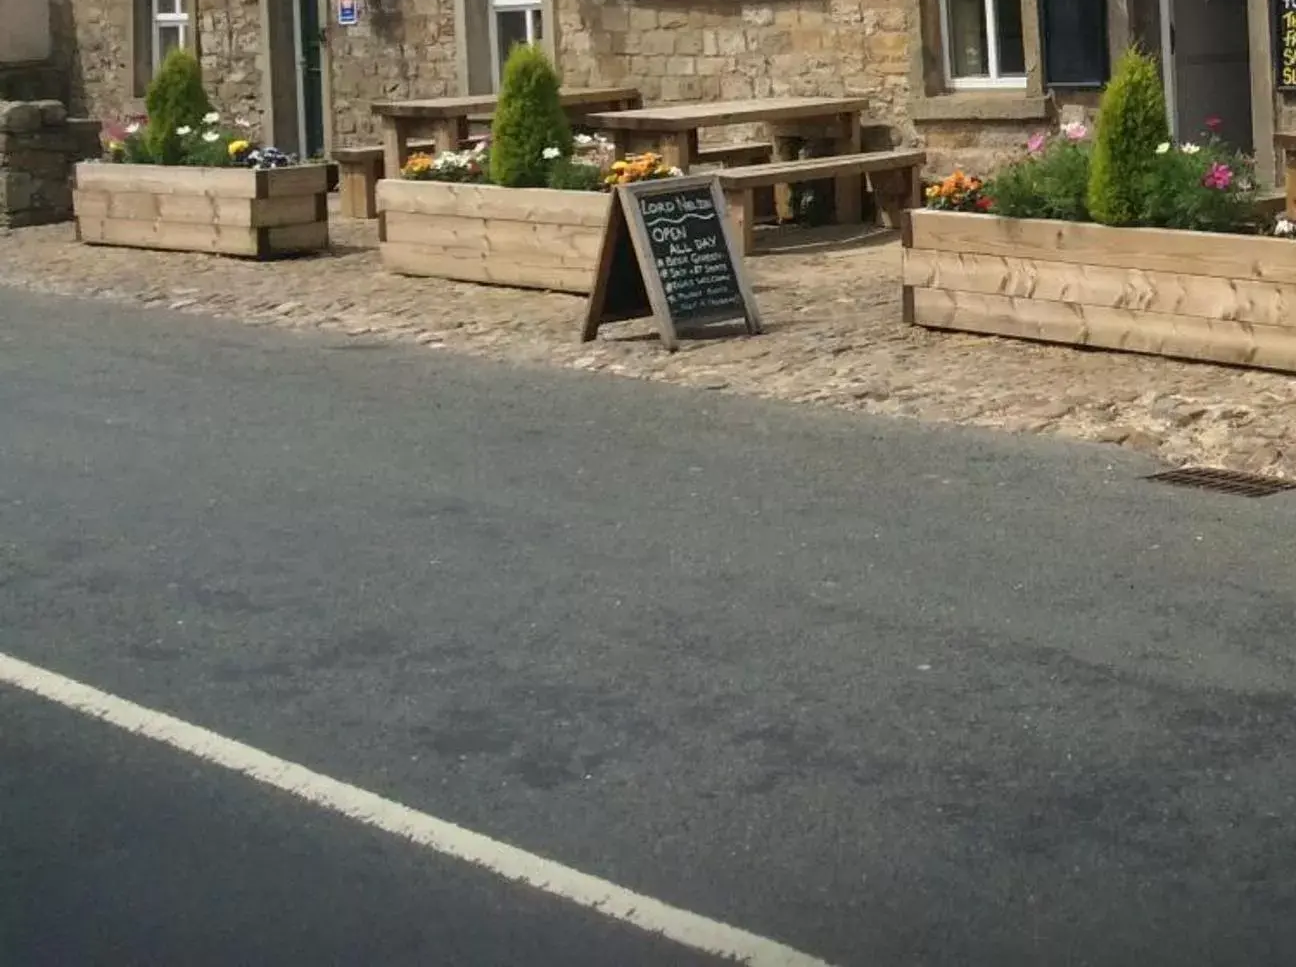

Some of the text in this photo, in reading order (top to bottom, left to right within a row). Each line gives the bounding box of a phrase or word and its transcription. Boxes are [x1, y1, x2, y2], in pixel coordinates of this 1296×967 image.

[652, 226, 687, 242] OPEN
[670, 236, 717, 255] ALL DAY
